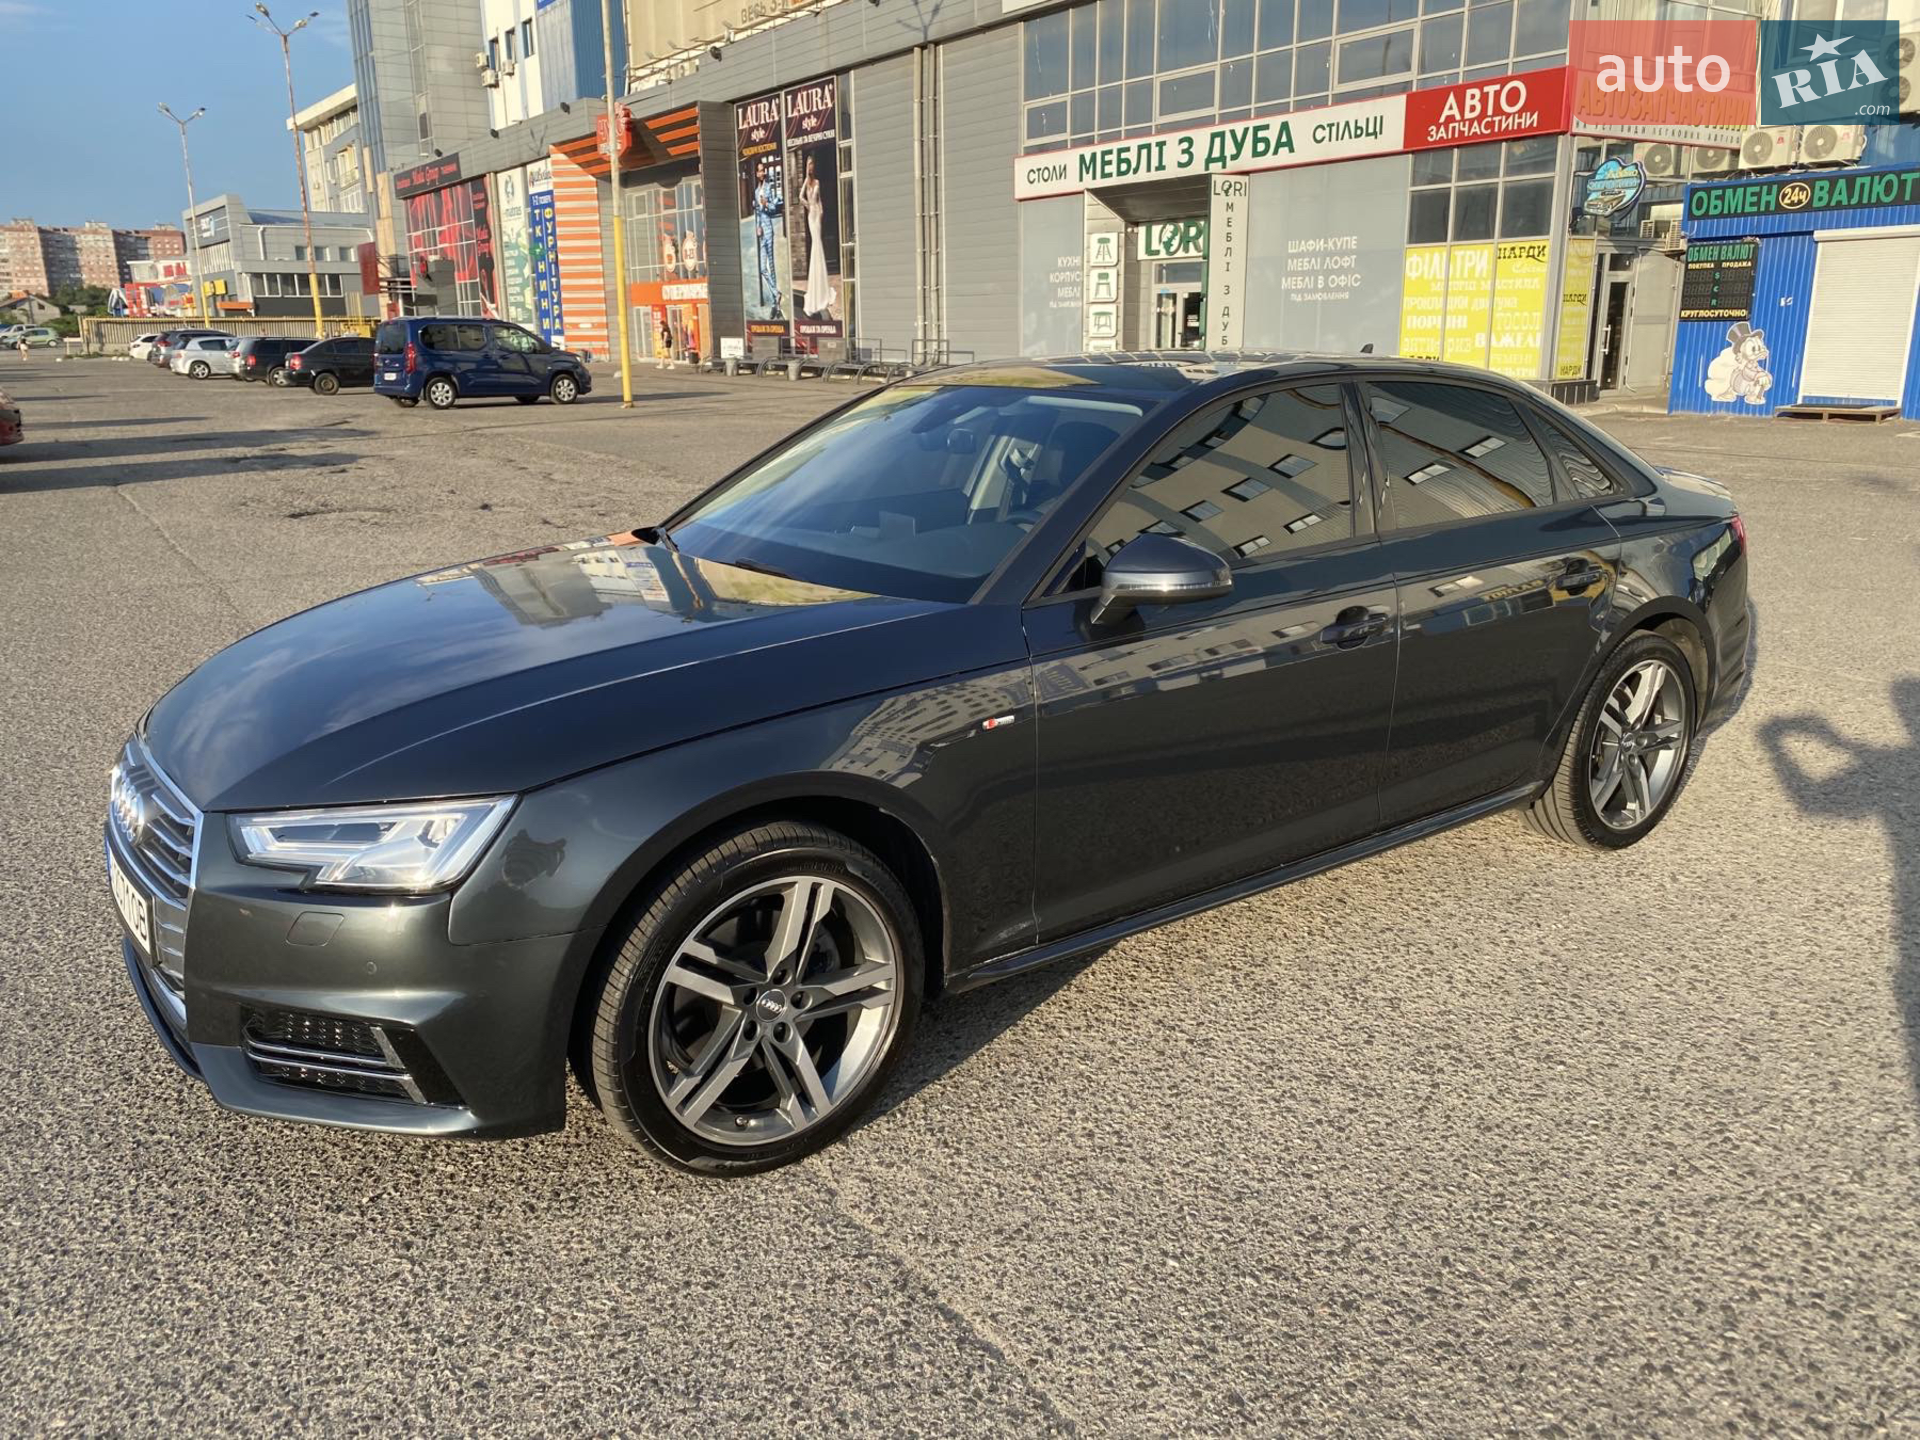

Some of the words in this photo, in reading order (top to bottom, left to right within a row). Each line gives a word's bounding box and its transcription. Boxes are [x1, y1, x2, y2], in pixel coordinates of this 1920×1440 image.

[738, 98, 779, 129] LAURA
[787, 84, 833, 118] LAURA
[1438, 80, 1527, 123] АВТО
[1427, 111, 1538, 142] ЗАПЧАСТИНИ
[1027, 164, 1067, 185] СТОЛИ
[1078, 140, 1167, 182] МЕБЛІ
[1204, 120, 1295, 171] ДУБА
[1312, 115, 1384, 144] СТІЛЬЦІ
[1214, 180, 1247, 197] LORI
[1691, 184, 1778, 217] ОБМЕН
[1783, 186, 1808, 204] 24ч
[1812, 172, 1920, 208] ВАЛЮТ
[1145, 221, 1207, 256] LOR
[1288, 236, 1358, 253] ШАФИ-КУПЕ
[1688, 246, 1719, 261] ОБМЕН
[1721, 244, 1755, 260] ВАЛЮТ
[1287, 257, 1320, 271] МЕБЛІ
[1324, 255, 1357, 269] ЛОФТ
[1281, 276, 1314, 290] МЕБЛІ
[1317, 275, 1325, 289] В
[1328, 273, 1361, 288] ОФІС
[1680, 309, 1747, 318] КРУГЛОСУТОЧНО
